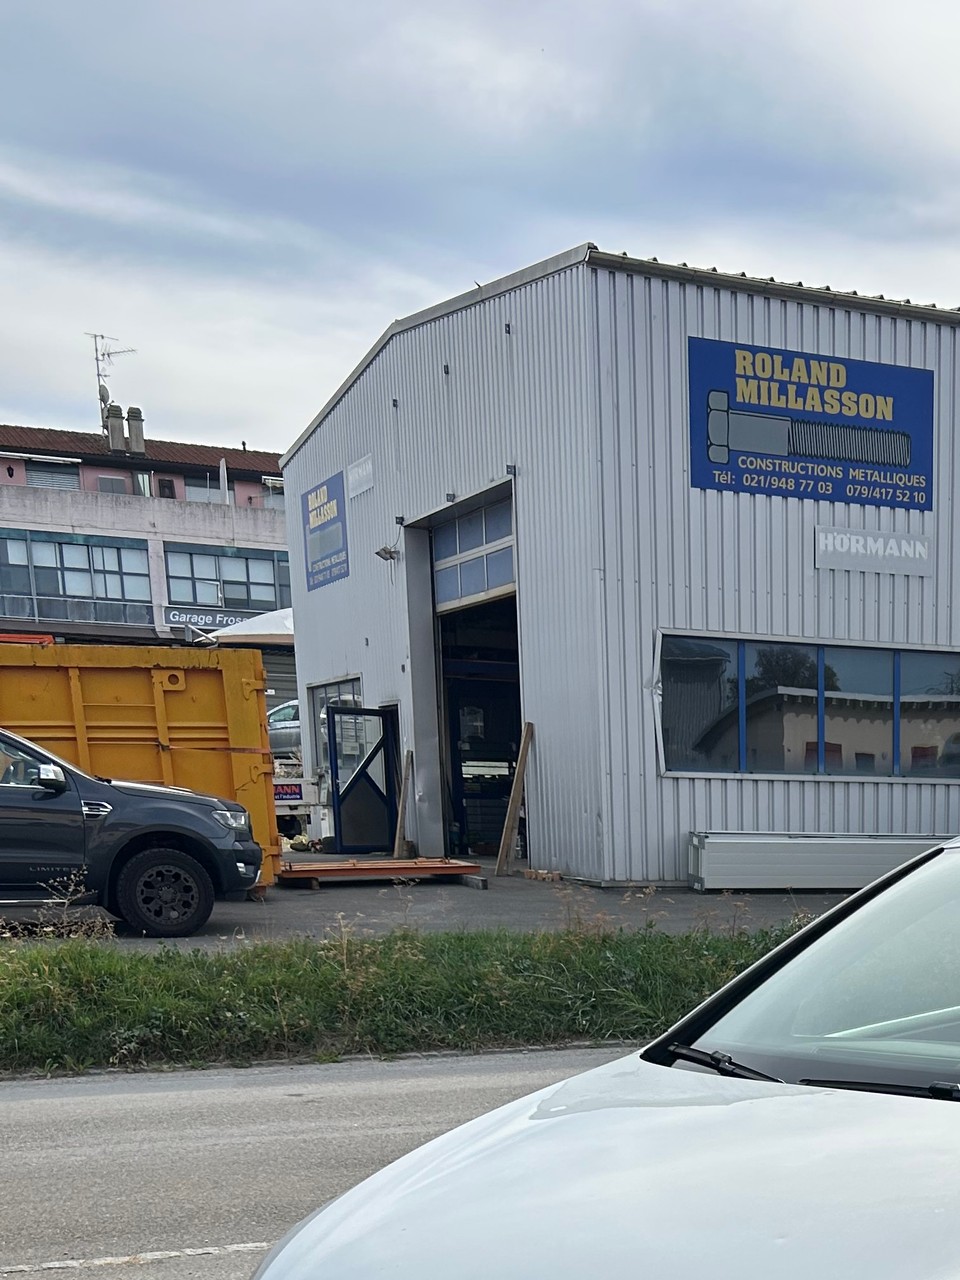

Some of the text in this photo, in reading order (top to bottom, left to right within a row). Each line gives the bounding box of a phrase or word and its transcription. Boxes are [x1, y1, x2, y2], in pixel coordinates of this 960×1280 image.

[735, 349, 847, 389] ROLAND
[735, 378, 894, 421] MILLASSON
[713, 471, 926, 503] Tél: 021/948 77 03 079/417 52 10
[738, 456, 926, 487] CONSTRUCTIONS METALLIQUES
[169, 611, 213, 626] Garage
